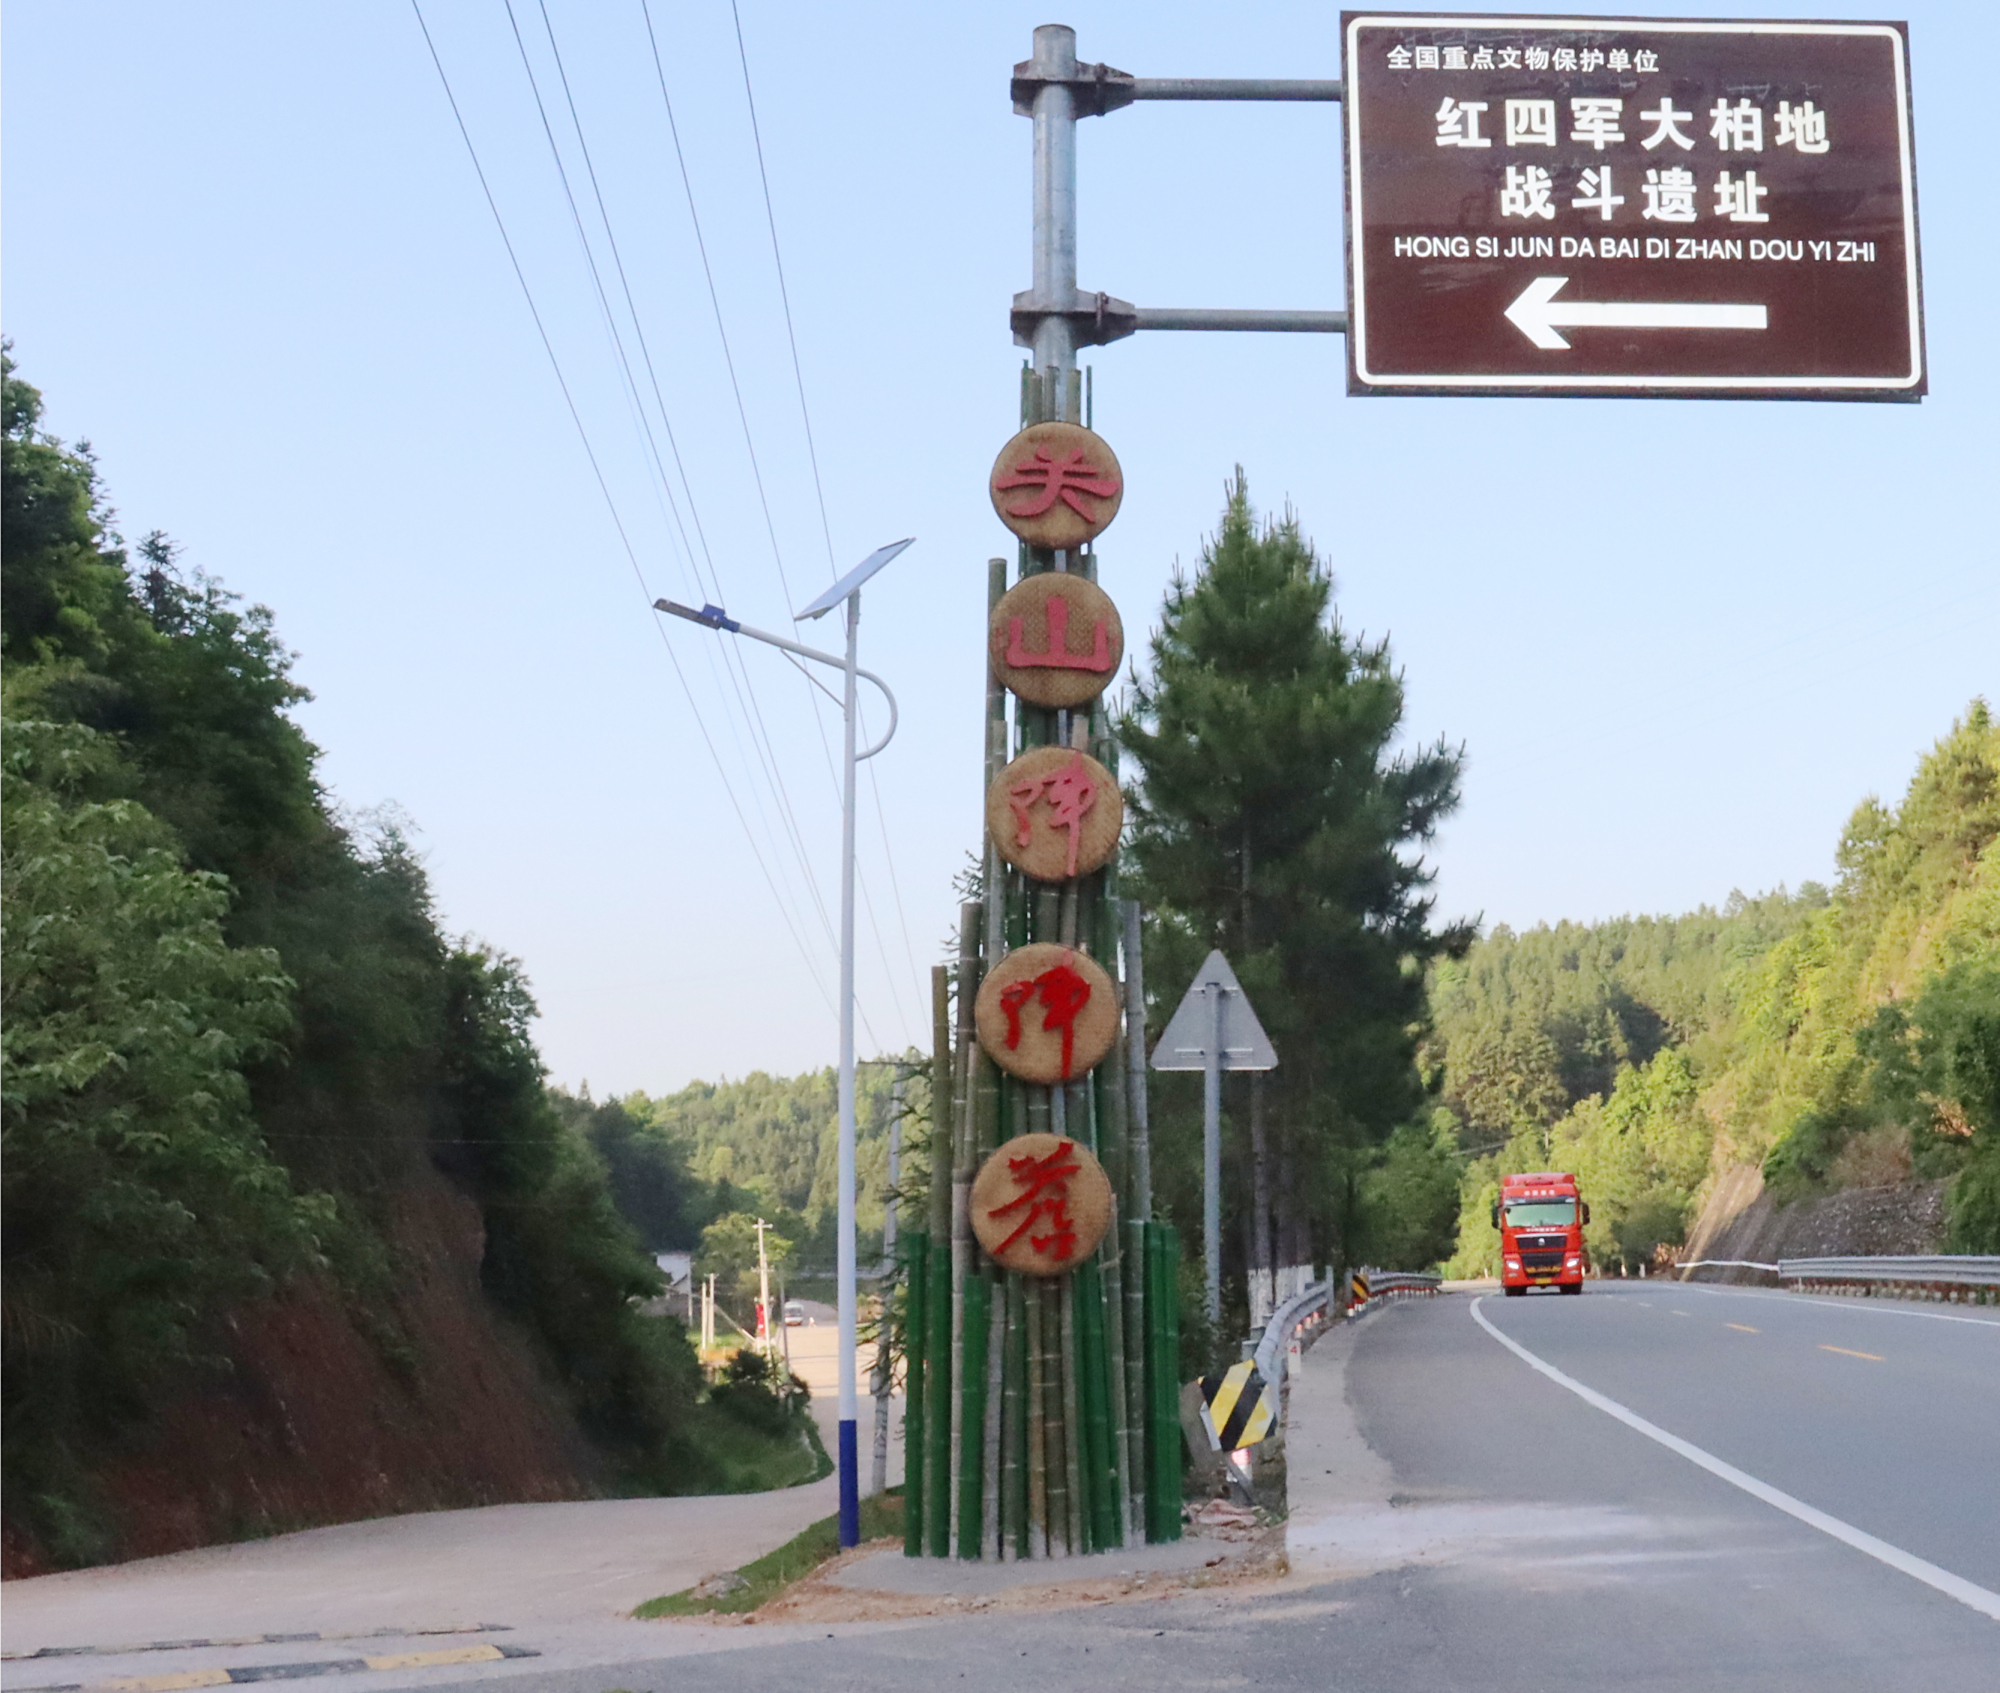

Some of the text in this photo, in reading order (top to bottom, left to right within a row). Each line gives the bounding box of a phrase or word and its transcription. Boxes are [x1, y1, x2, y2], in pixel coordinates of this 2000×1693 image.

[1386, 44, 1660, 74] 全国重点文物保护单位
[1434, 96, 1830, 154] 红四军大柏地
[1500, 165, 1770, 223] 战斗遗址
[1394, 236, 1876, 262] HONG SI JUN DA BAI DI ZHAN DOU YI ZHI
